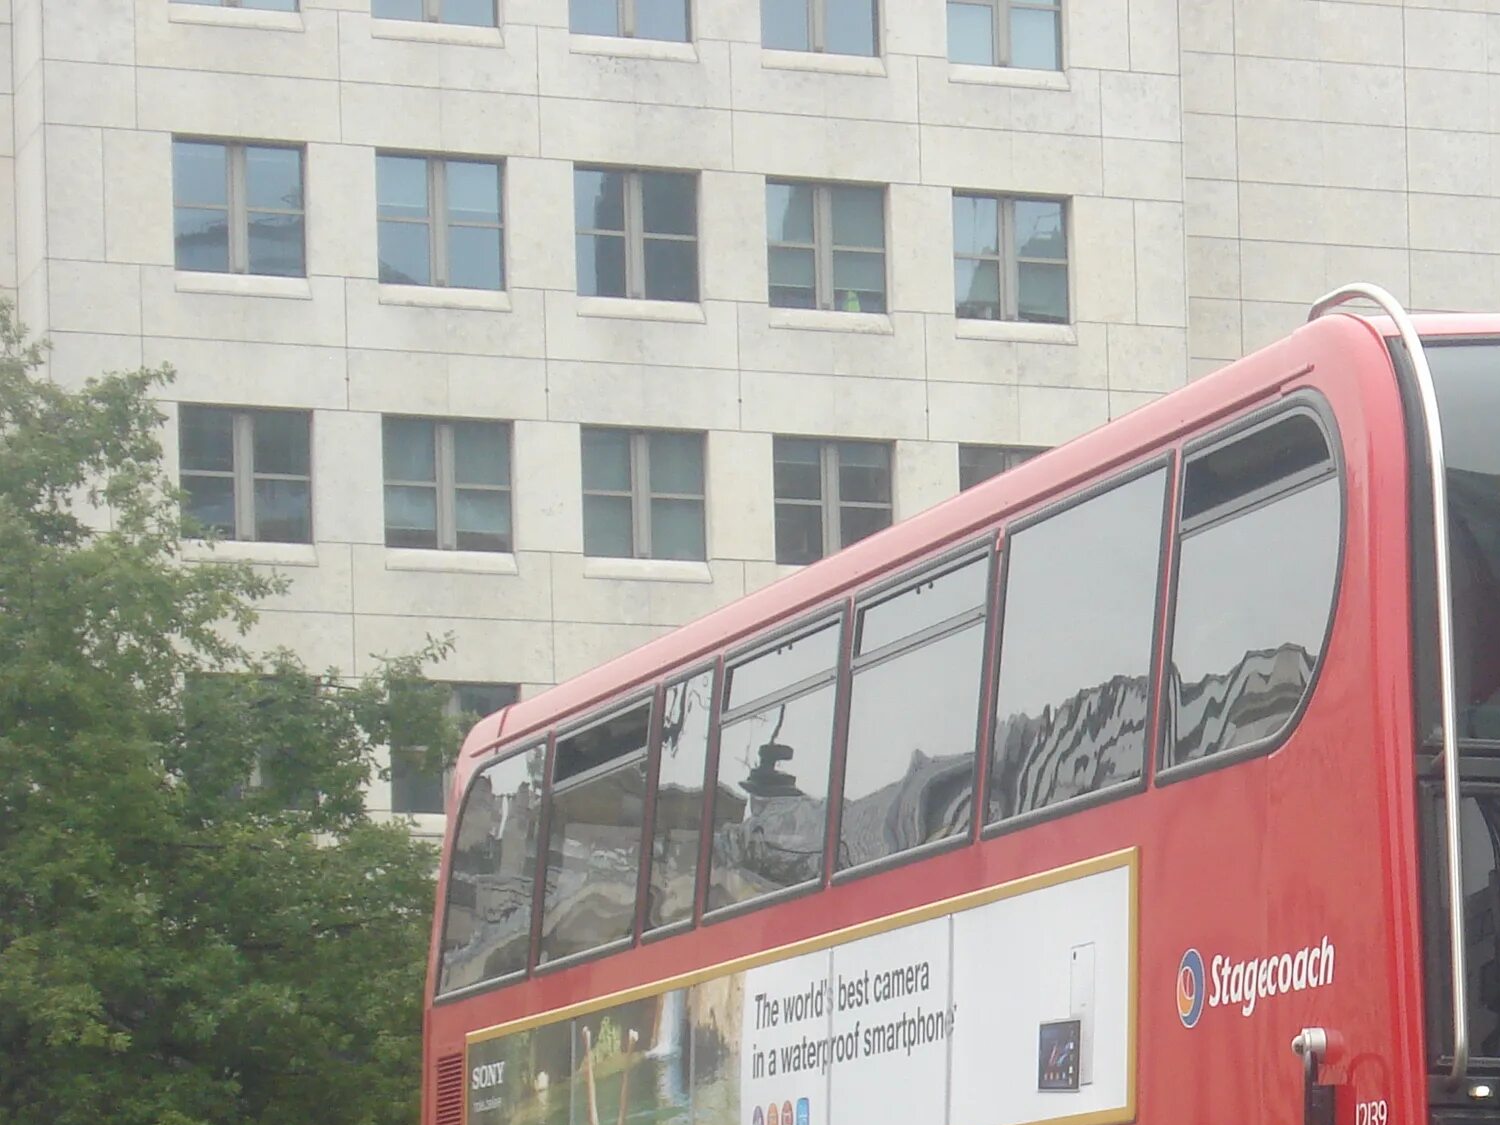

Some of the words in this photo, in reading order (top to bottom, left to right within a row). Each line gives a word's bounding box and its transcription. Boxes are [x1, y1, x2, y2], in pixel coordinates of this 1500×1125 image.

[754, 993, 780, 1030] The
[783, 978, 834, 1025] world's
[838, 969, 870, 1012] best
[873, 961, 930, 1004] camera
[1208, 935, 1335, 1017] Stagecoach
[472, 1061, 505, 1090] SONY
[752, 1043, 765, 1079] in
[768, 1048, 777, 1076] a
[781, 1020, 860, 1076] waterproof
